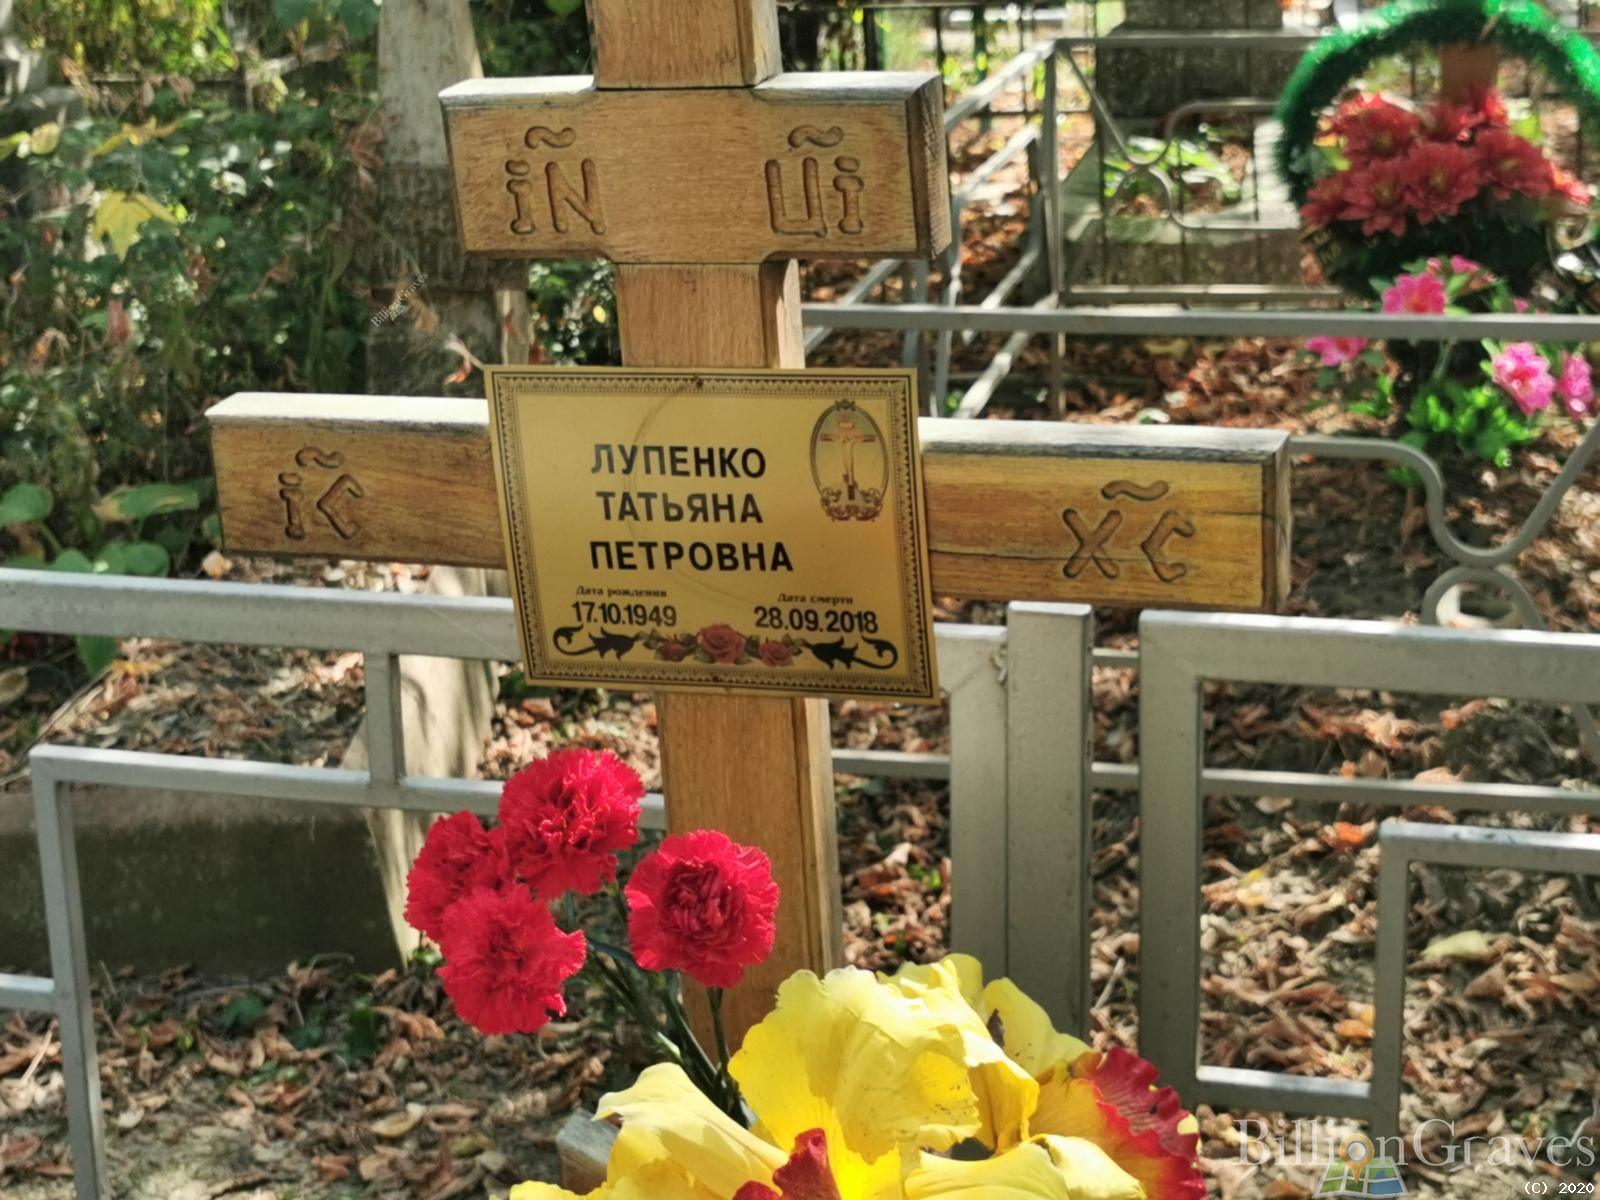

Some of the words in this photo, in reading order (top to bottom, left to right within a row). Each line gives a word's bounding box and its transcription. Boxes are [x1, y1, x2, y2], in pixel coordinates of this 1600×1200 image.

[591, 443, 767, 479] ЛУПЕНКО
[595, 491, 764, 524] ТАТЬЯНА
[589, 541, 795, 572] ПЕТРОВНА
[576, 585, 604, 596] Дата
[607, 588, 667, 598] рождения
[777, 593, 807, 603] Дата
[810, 595, 854, 606] смерти
[571, 601, 677, 627] 17.10.1949
[754, 606, 879, 633] 28.09.2018
